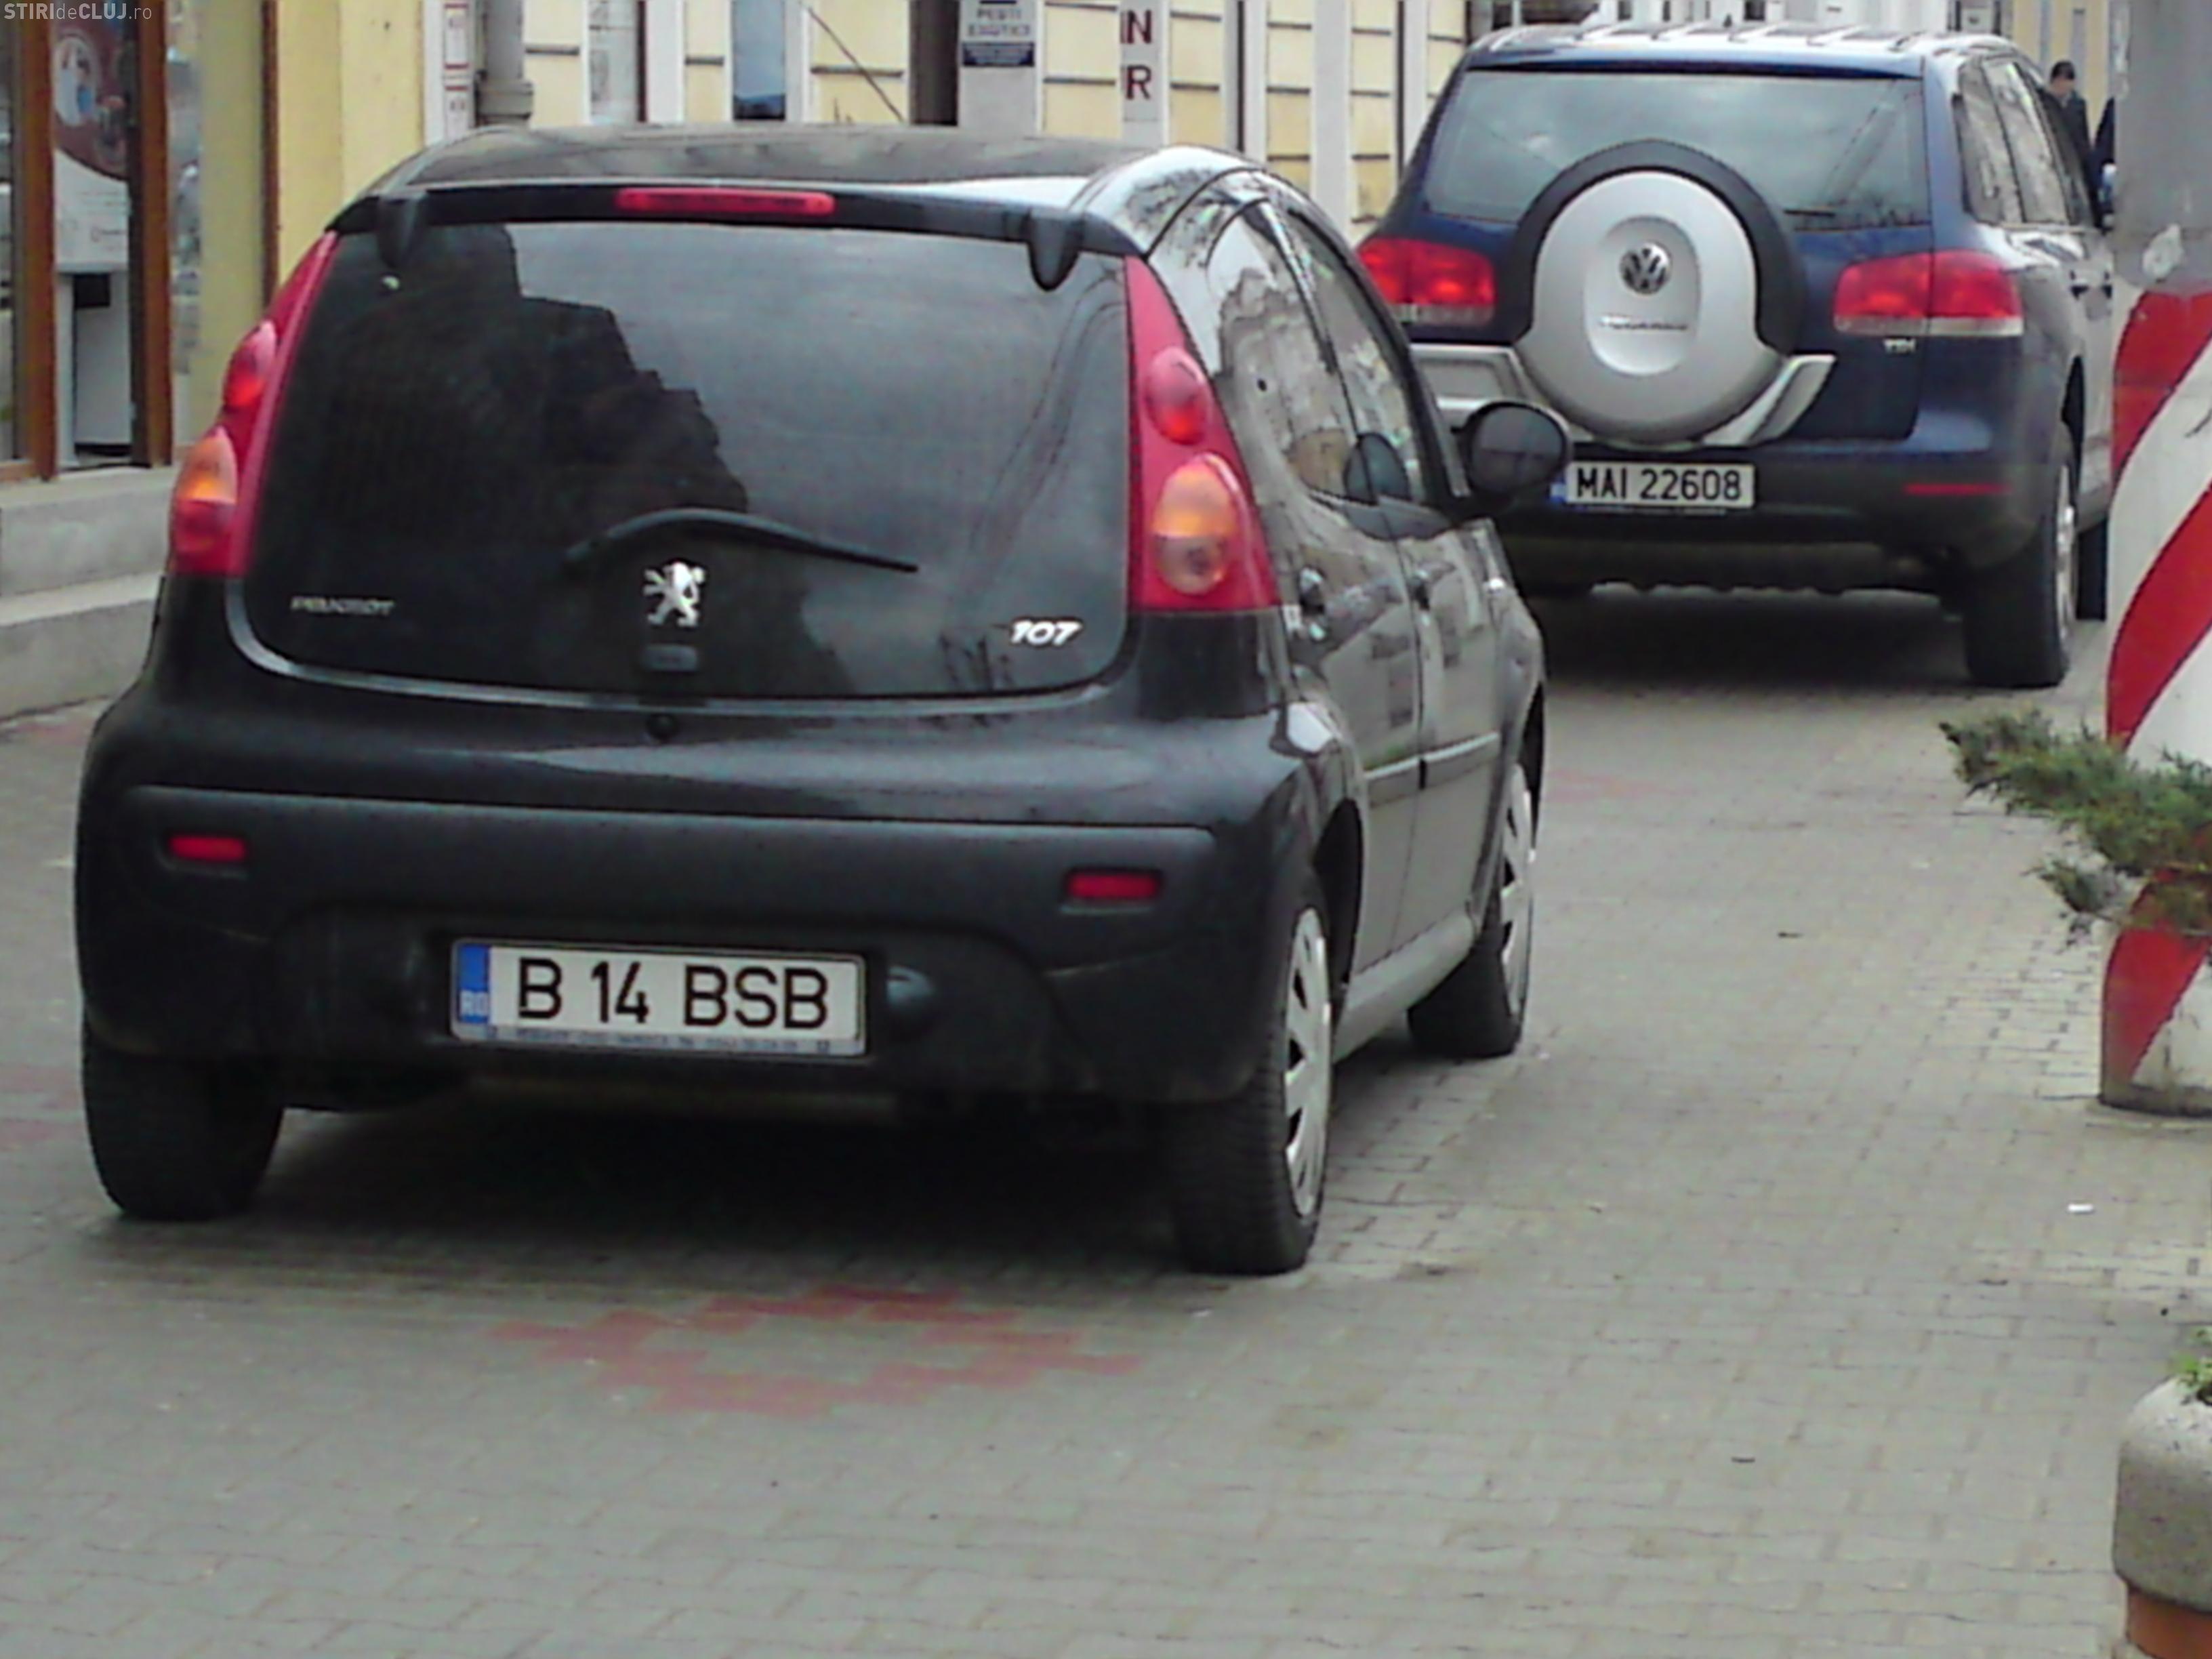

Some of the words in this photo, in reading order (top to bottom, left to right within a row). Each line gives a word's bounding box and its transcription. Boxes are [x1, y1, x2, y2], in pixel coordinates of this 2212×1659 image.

[1577, 467, 1627, 499] MAI
[1640, 468, 1740, 501] 22608
[1010, 619, 1083, 647] 107
[518, 957, 562, 1021] B
[590, 961, 650, 1024] 14
[683, 963, 829, 1030] BSB
